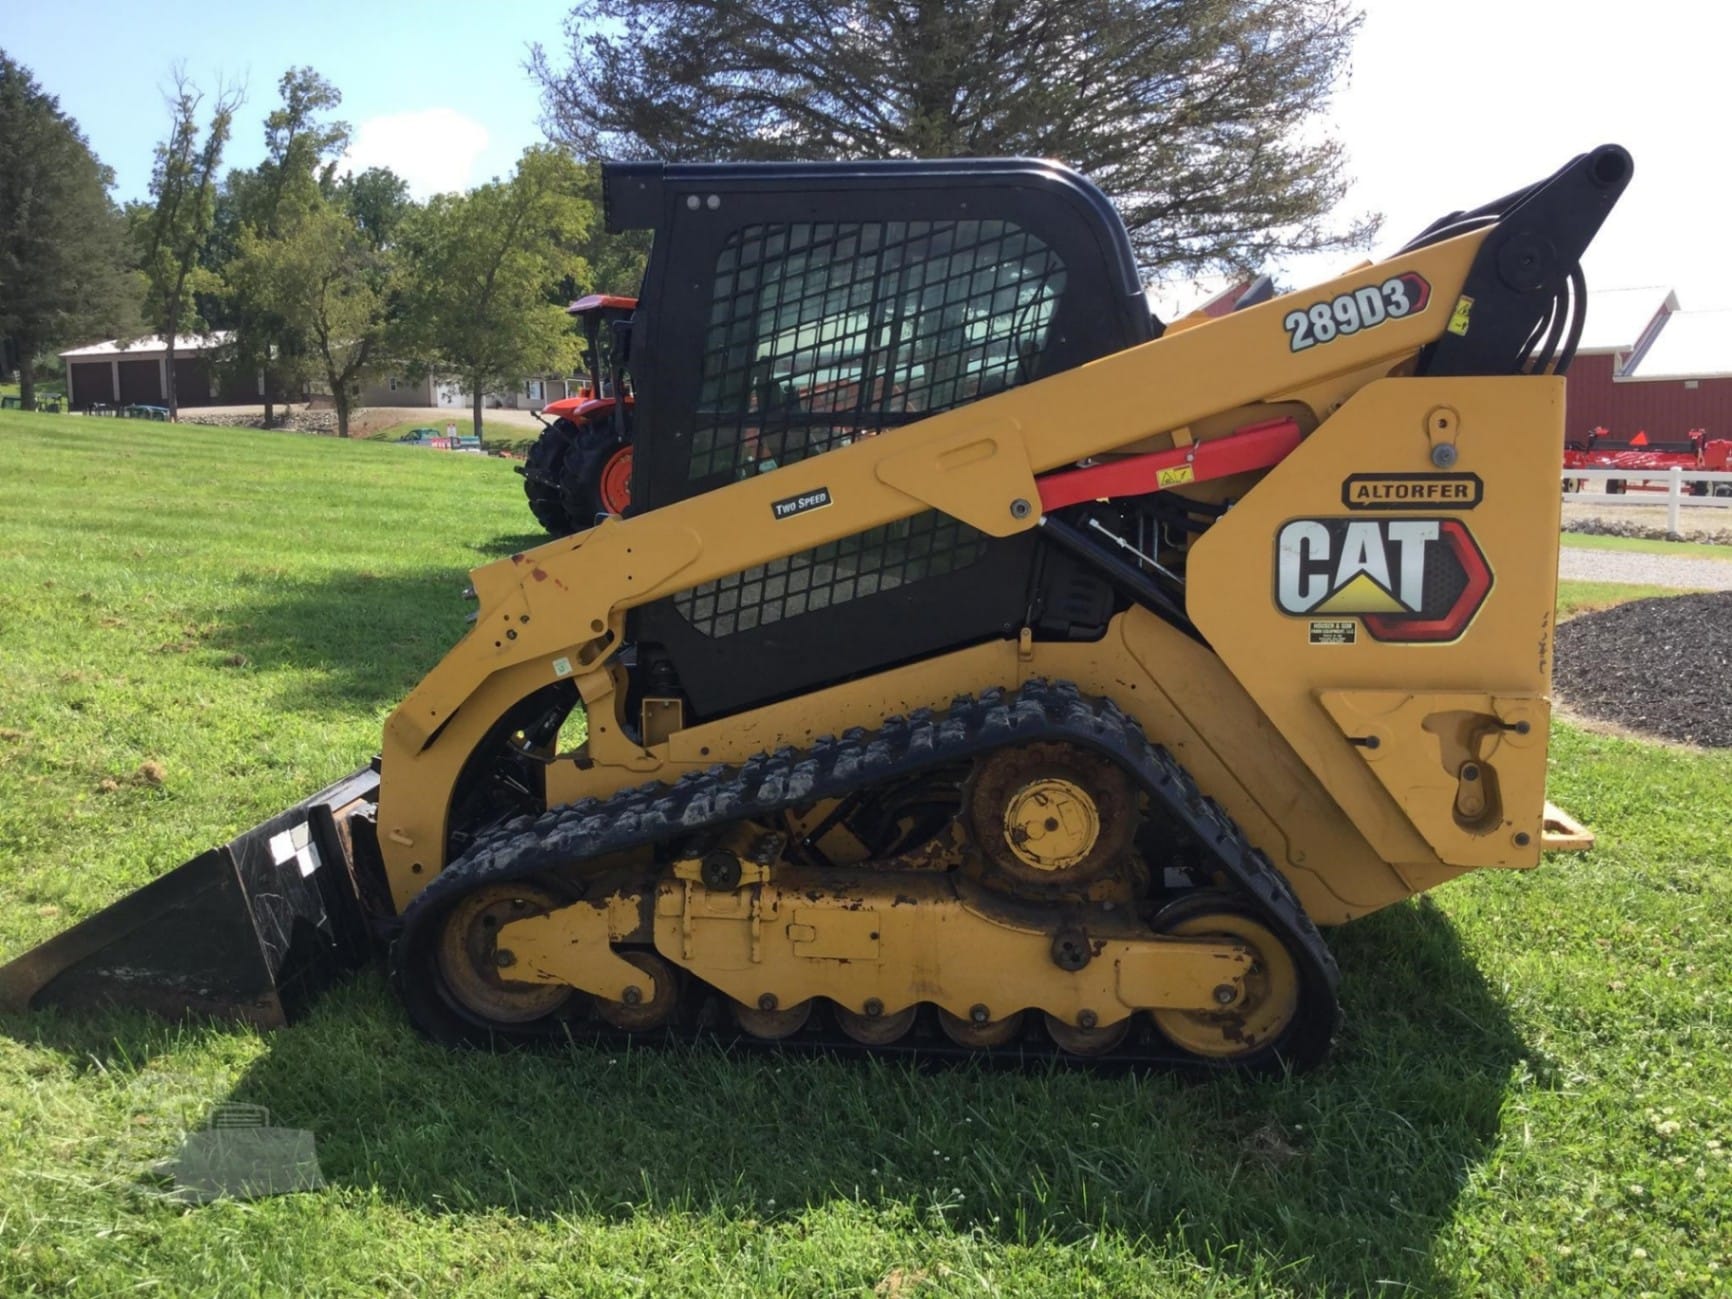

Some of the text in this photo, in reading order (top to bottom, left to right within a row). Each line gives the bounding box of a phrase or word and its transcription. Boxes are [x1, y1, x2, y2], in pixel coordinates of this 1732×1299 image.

[1285, 278, 1410, 352] 289D3
[1357, 484, 1469, 498] ALTORFER
[1279, 520, 1439, 613] CAT
